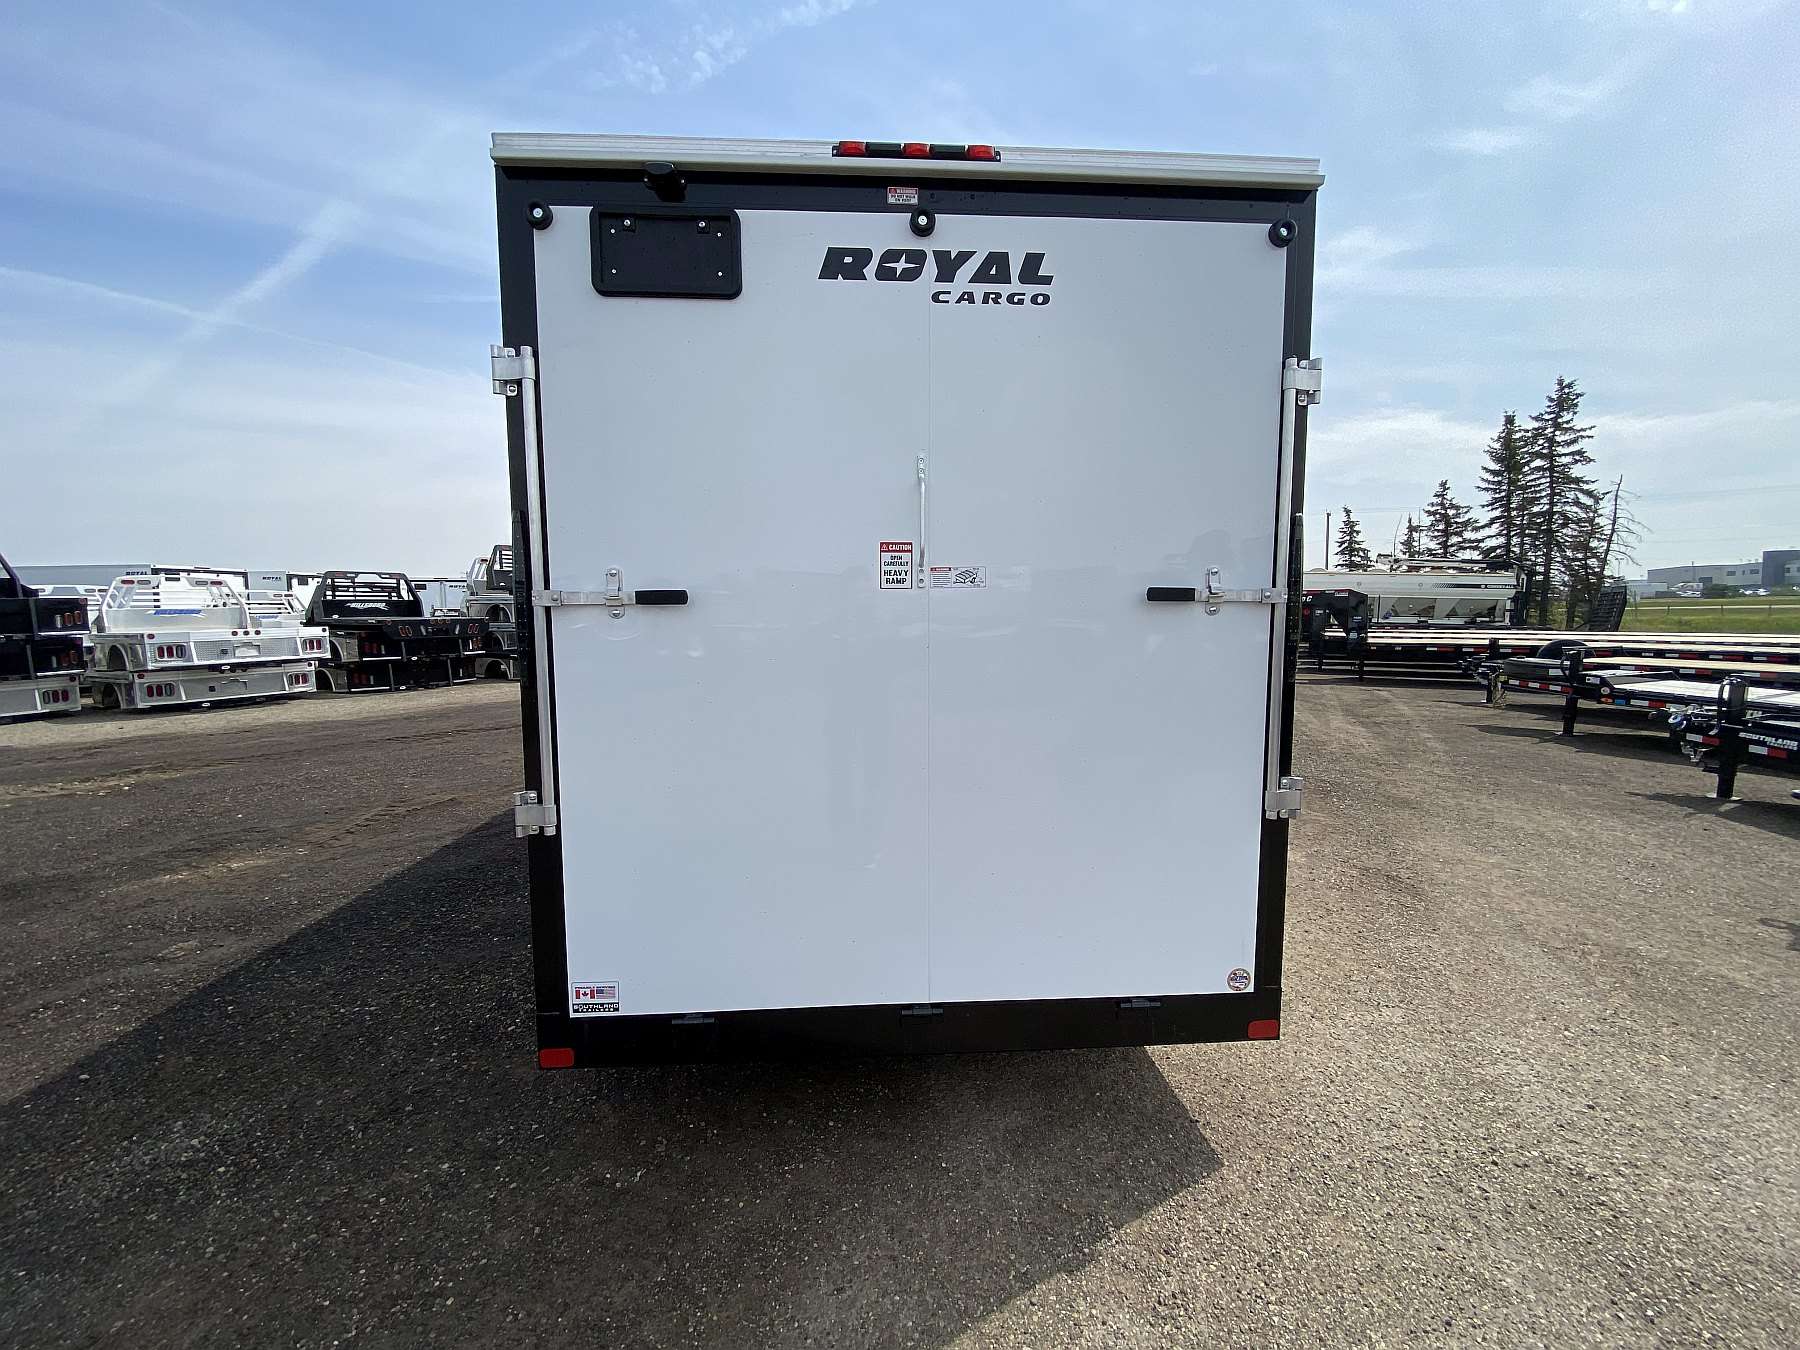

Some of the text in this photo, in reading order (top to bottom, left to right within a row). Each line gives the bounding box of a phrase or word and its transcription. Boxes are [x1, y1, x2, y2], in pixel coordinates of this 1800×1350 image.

[818, 247, 1055, 286] ROYAL
[931, 290, 1051, 306] CARGO
[1738, 731, 1798, 747] SOUTHLAND
